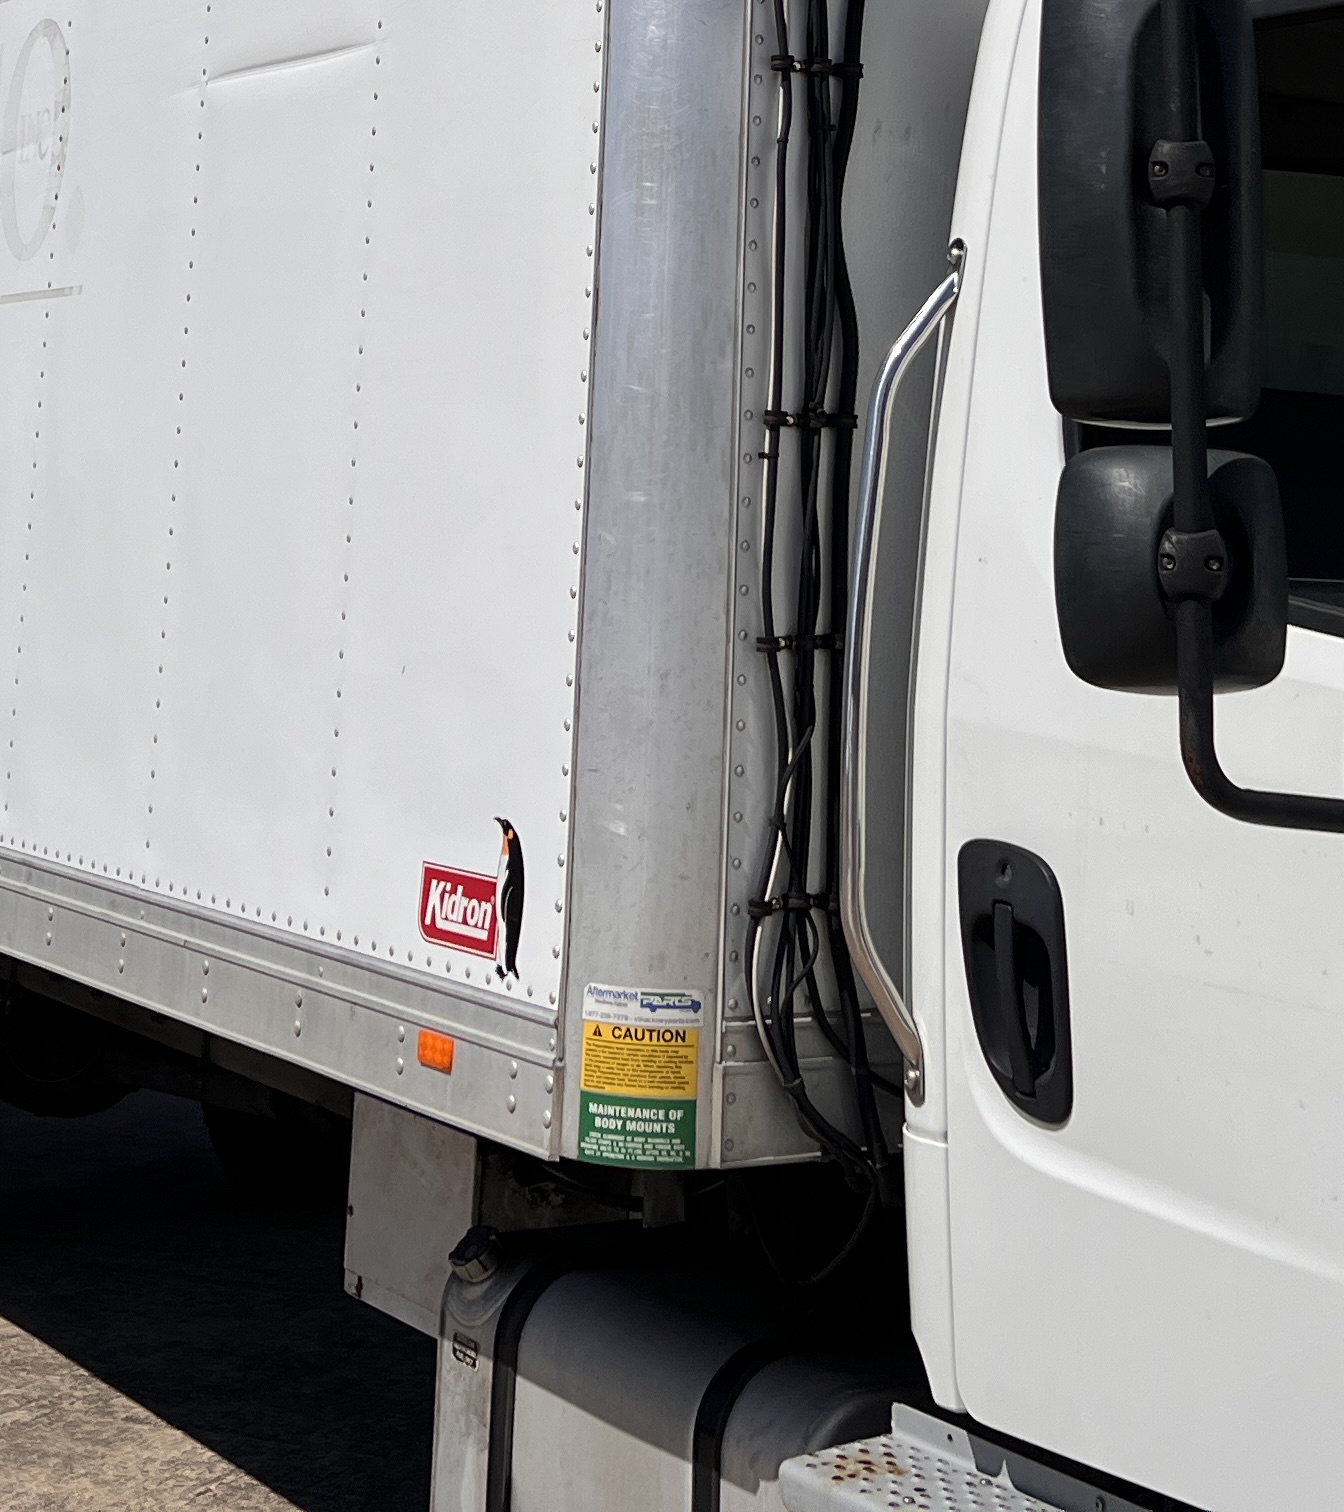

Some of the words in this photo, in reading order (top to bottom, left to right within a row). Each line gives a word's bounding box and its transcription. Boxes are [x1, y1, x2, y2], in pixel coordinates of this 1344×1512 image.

[424, 878, 493, 931] Kidron
[586, 985, 639, 1001] Aftermarket
[611, 1026, 686, 1043] CAUTION
[588, 1102, 666, 1121] MAINTENANCE
[668, 1109, 684, 1121] OF
[594, 1116, 623, 1131] BODY
[625, 1119, 676, 1134] MOUNTS
